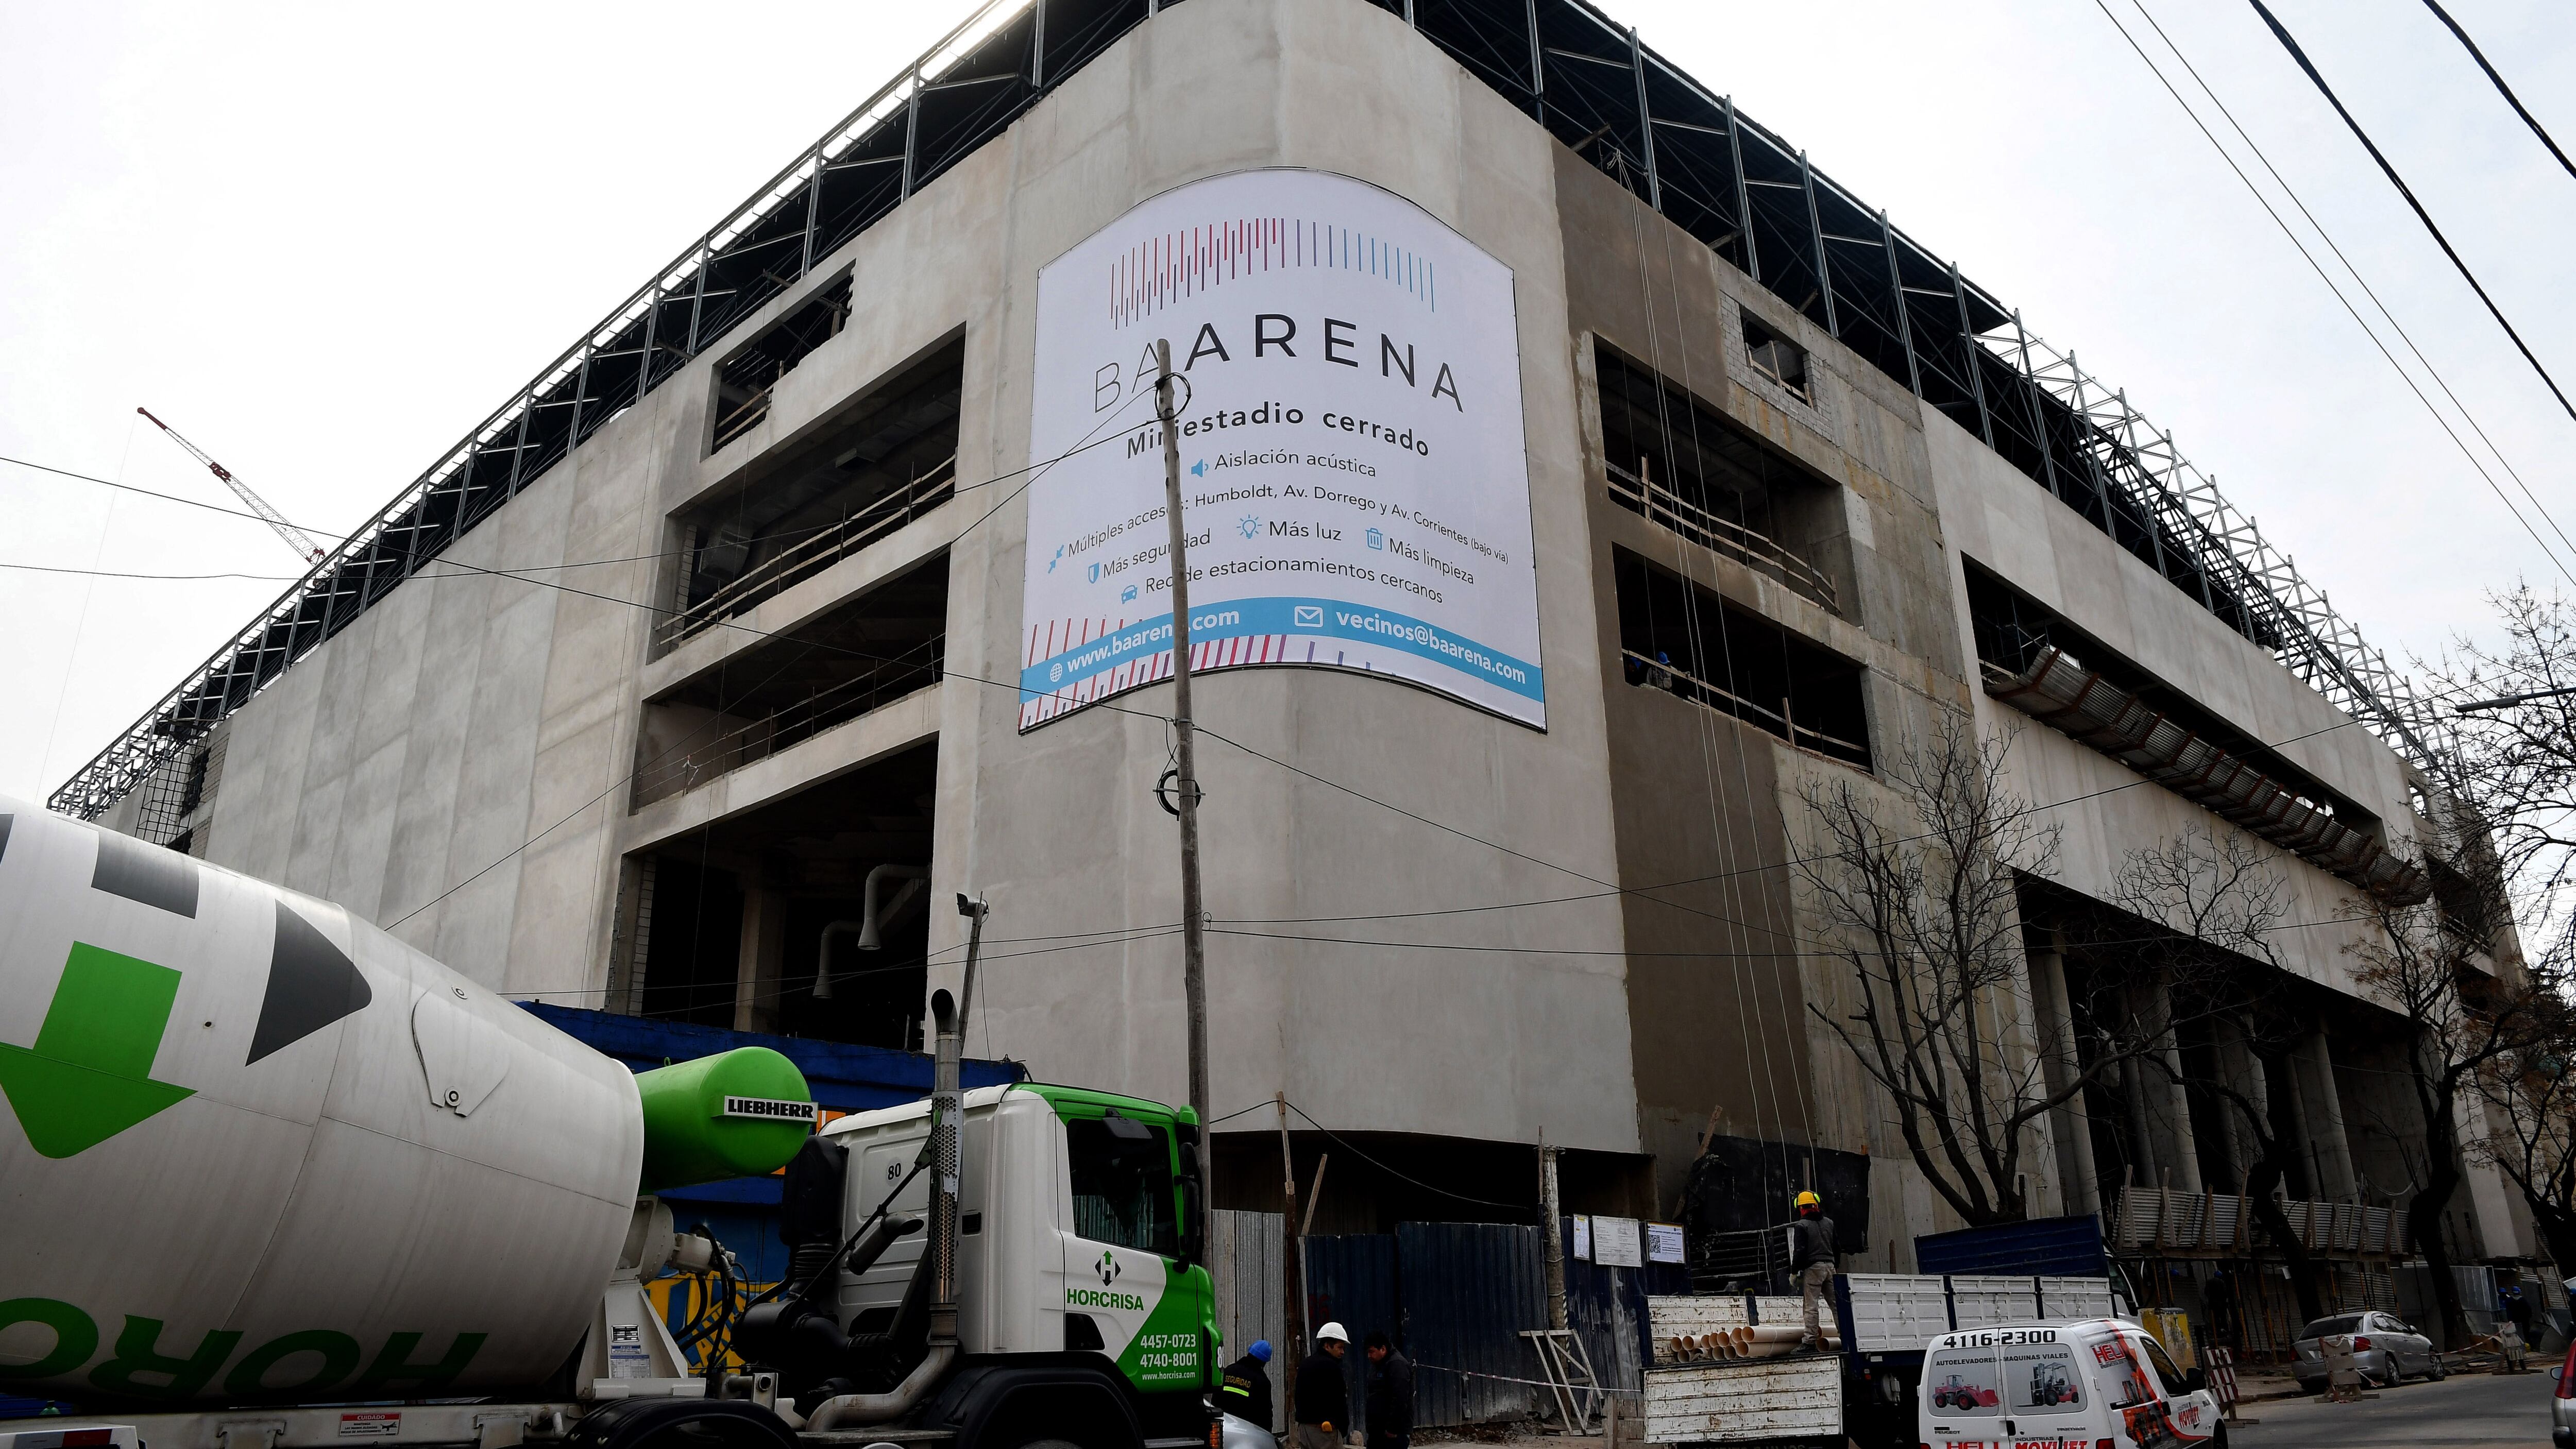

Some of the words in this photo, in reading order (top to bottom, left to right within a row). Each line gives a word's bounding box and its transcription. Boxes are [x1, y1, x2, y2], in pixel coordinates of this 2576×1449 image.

[1323, 413, 1429, 456] cerrado
[1214, 449, 1299, 470] Aislación
[1307, 453, 1376, 477] acústica
[1069, 524, 1123, 557] Múltiples
[1127, 499, 1189, 530] acces:
[1195, 484, 1278, 507] Humboldt,
[1283, 485, 1308, 498] Av.
[1314, 486, 1376, 510] Dorrego
[1380, 503, 1387, 515] y
[1392, 504, 1410, 520] Av.
[1414, 512, 1468, 545] Corrientes
[1471, 538, 1492, 556] (bajo
[1494, 550, 1509, 565] vía)
[1269, 521, 1309, 536] Más
[1316, 522, 1342, 541] luz
[1103, 557, 1128, 578] Más
[1133, 527, 1210, 563] segurdad
[1389, 538, 1419, 561] Más
[1423, 549, 1474, 585] limpieza
[1210, 556, 1375, 582] estacionamientos
[1381, 573, 1443, 603] cercanos
[1067, 610, 1240, 672] www.baaren.com
[1336, 611, 1526, 684] vecinos@baarena.com
[728, 1098, 814, 1119] LIEBHERR
[887, 1163, 902, 1180] 80
[1067, 1288, 1144, 1311] HORCRISA
[1140, 1334, 1196, 1349] 4457-0723
[1943, 1330, 2056, 1348] 4116-2300
[1140, 1353, 1197, 1368] 4740-8001
[1936, 1357, 1997, 1366] AUTOELEVADORES
[1142, 1371, 1195, 1380] www.horcrisa.com
[1225, 1375, 1251, 1388] SEGURIDAD
